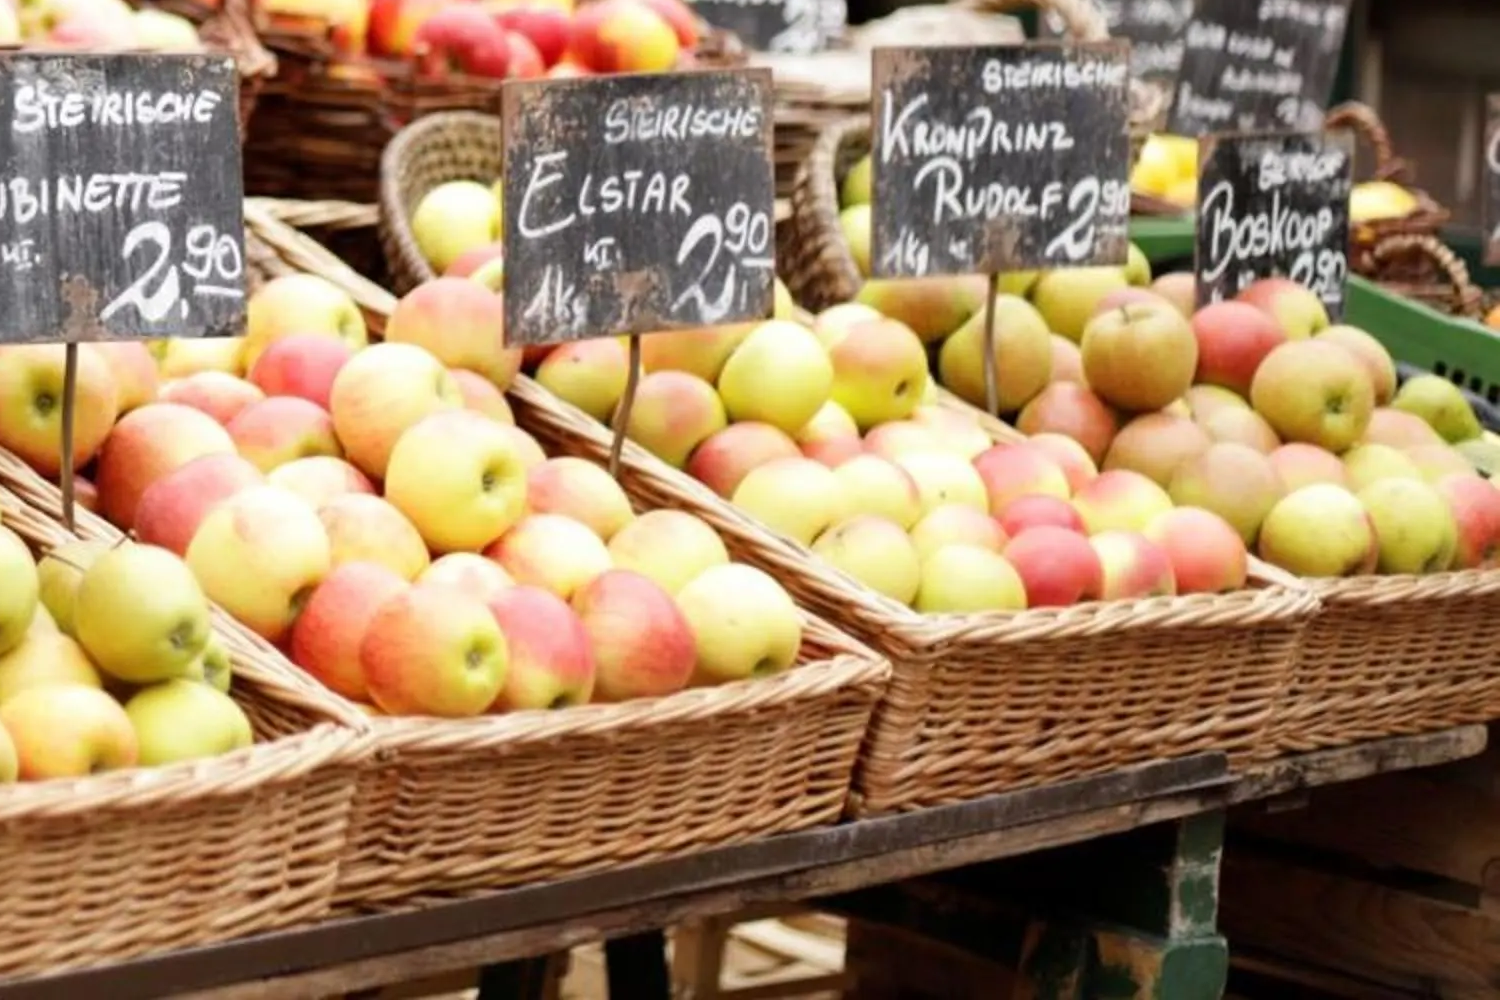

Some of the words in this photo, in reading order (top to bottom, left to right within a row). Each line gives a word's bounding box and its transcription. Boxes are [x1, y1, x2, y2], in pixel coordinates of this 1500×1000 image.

[11, 82, 221, 133] STEIRISCHE
[518, 151, 692, 238] ELSTAR
[913, 156, 1062, 225] RUDOLF
